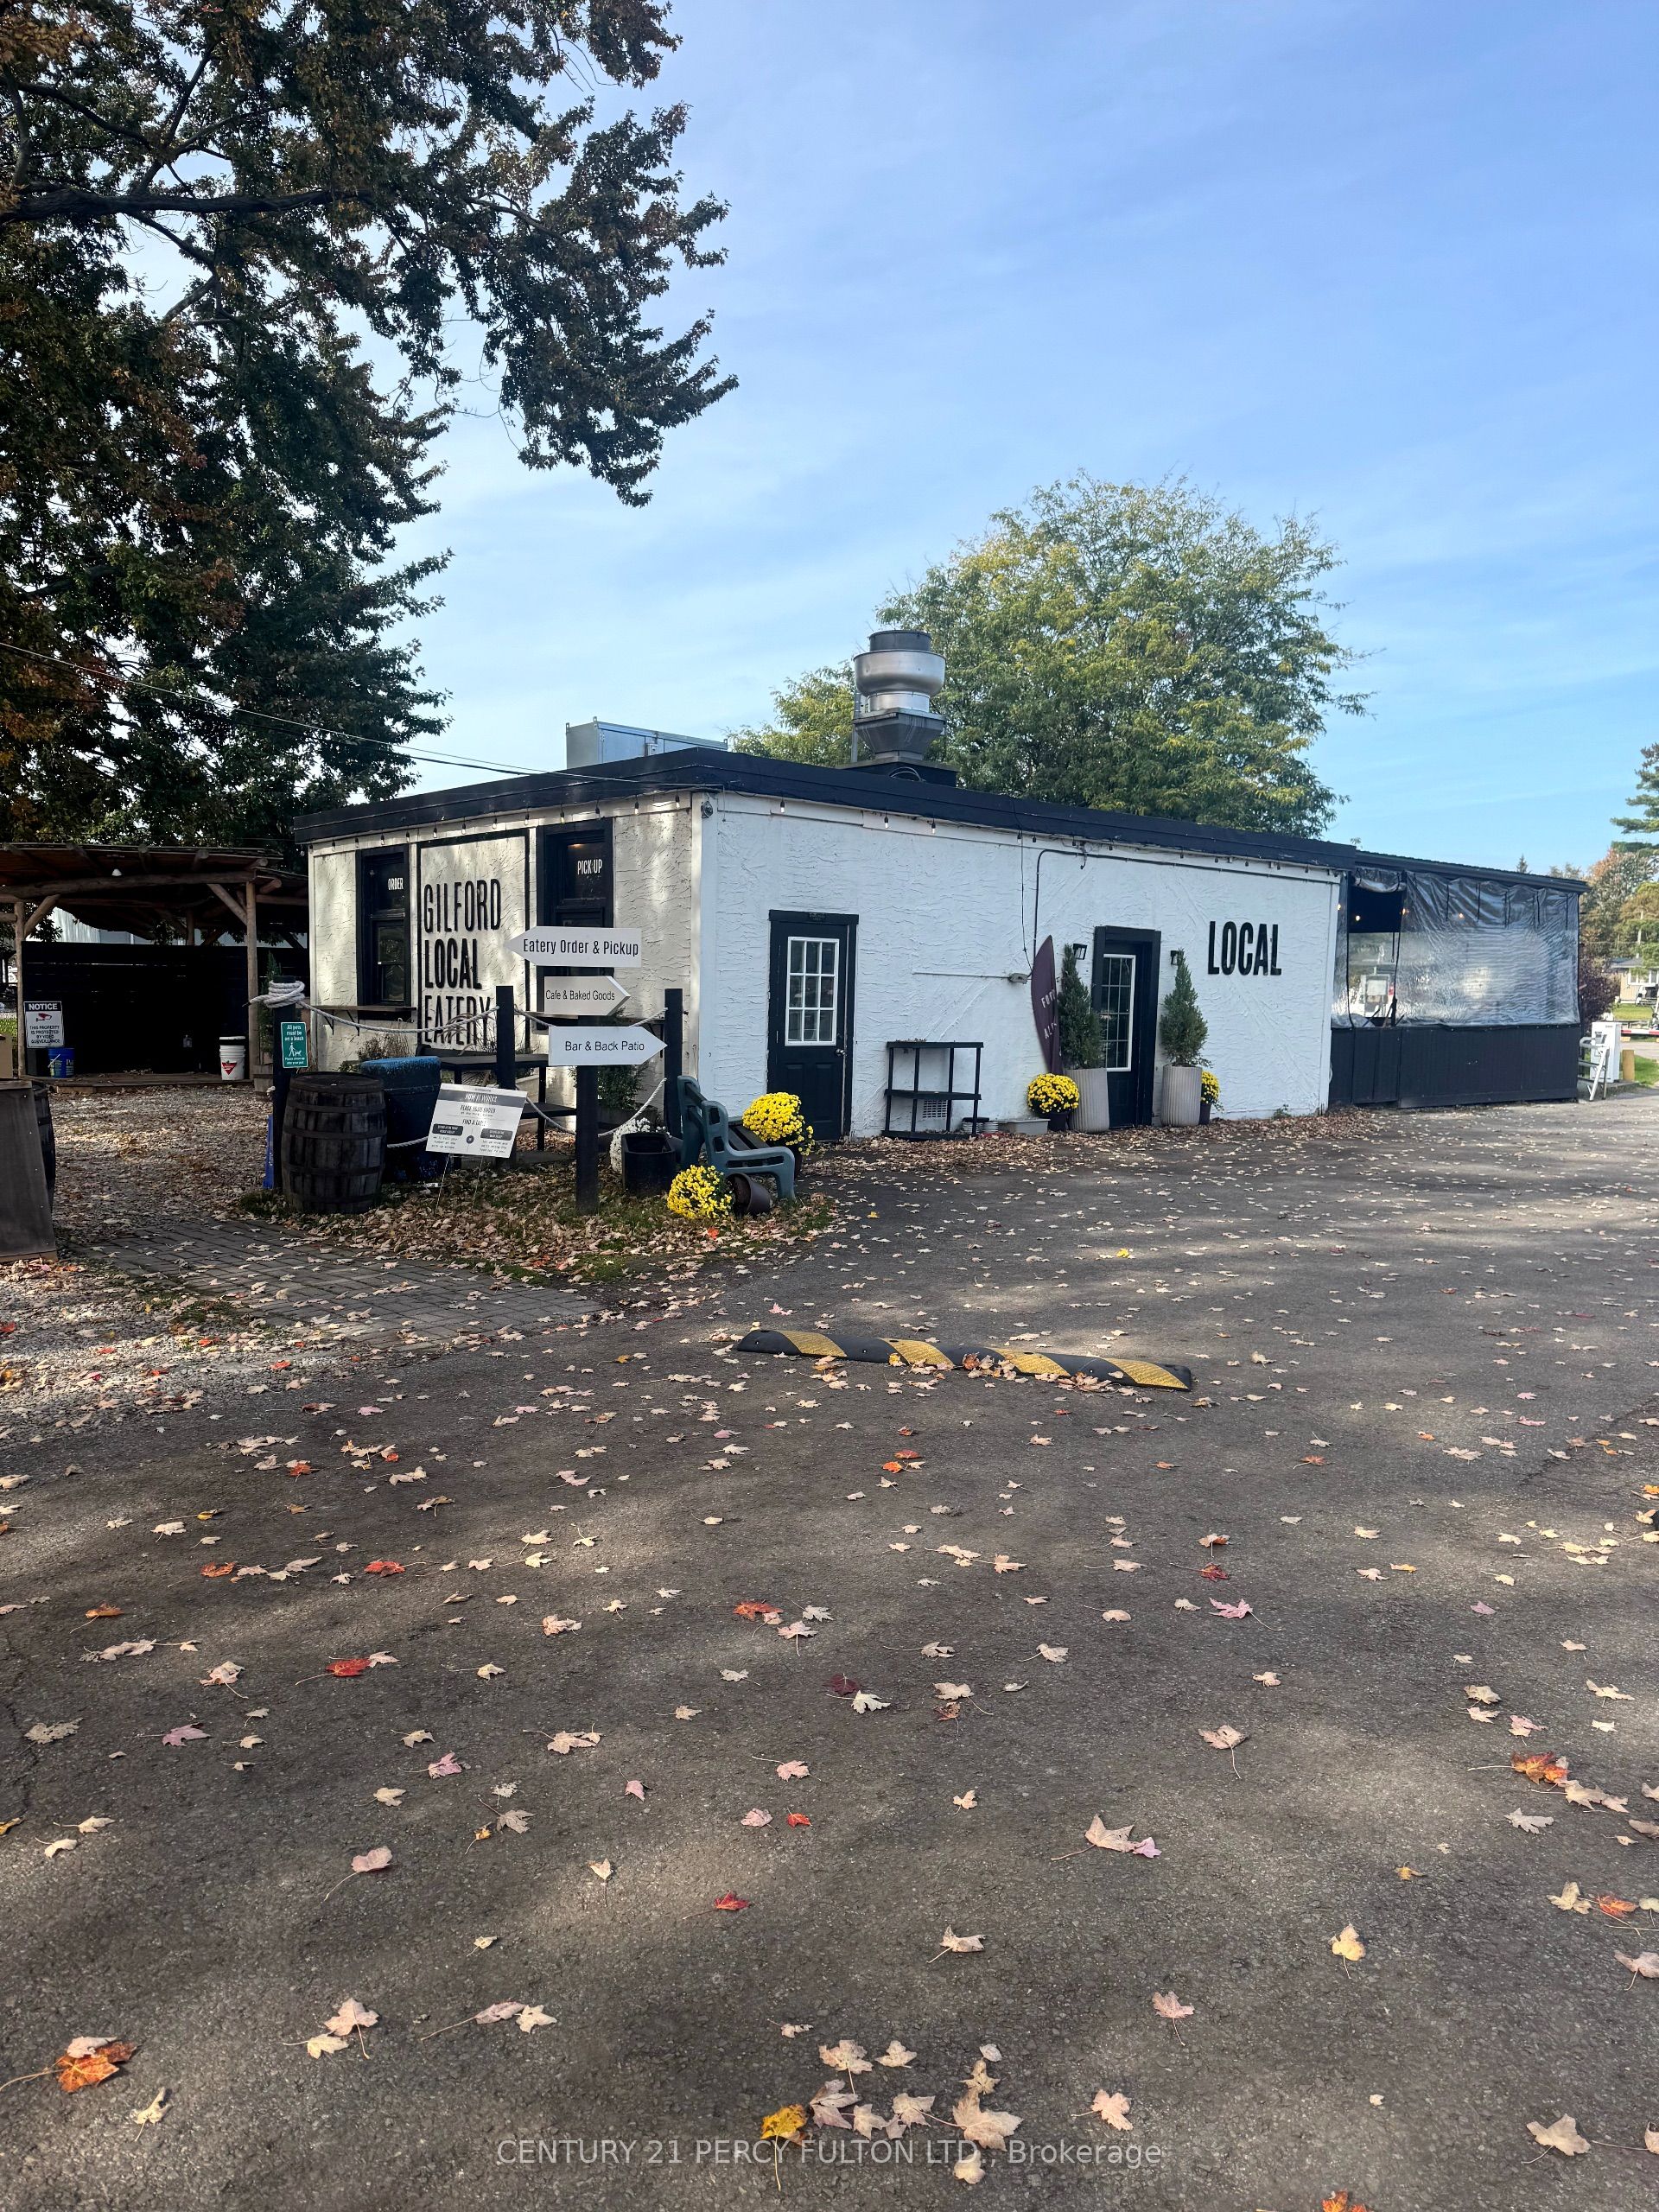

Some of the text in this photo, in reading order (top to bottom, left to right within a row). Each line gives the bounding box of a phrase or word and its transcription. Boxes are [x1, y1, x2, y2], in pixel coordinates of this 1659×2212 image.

[578, 859, 603, 874] PICK UP
[388, 877, 404, 890] ORDER
[423, 878, 501, 933] GILFORD
[523, 938, 639, 957] Eatery Order & Pickup
[1207, 921, 1282, 976] LOCAL
[424, 938, 482, 989] LOCAL
[545, 989, 615, 1001] Cafe & Baked Goods
[424, 995, 491, 1046] EATERY
[565, 1040, 645, 1051] Bar & Back Patio
